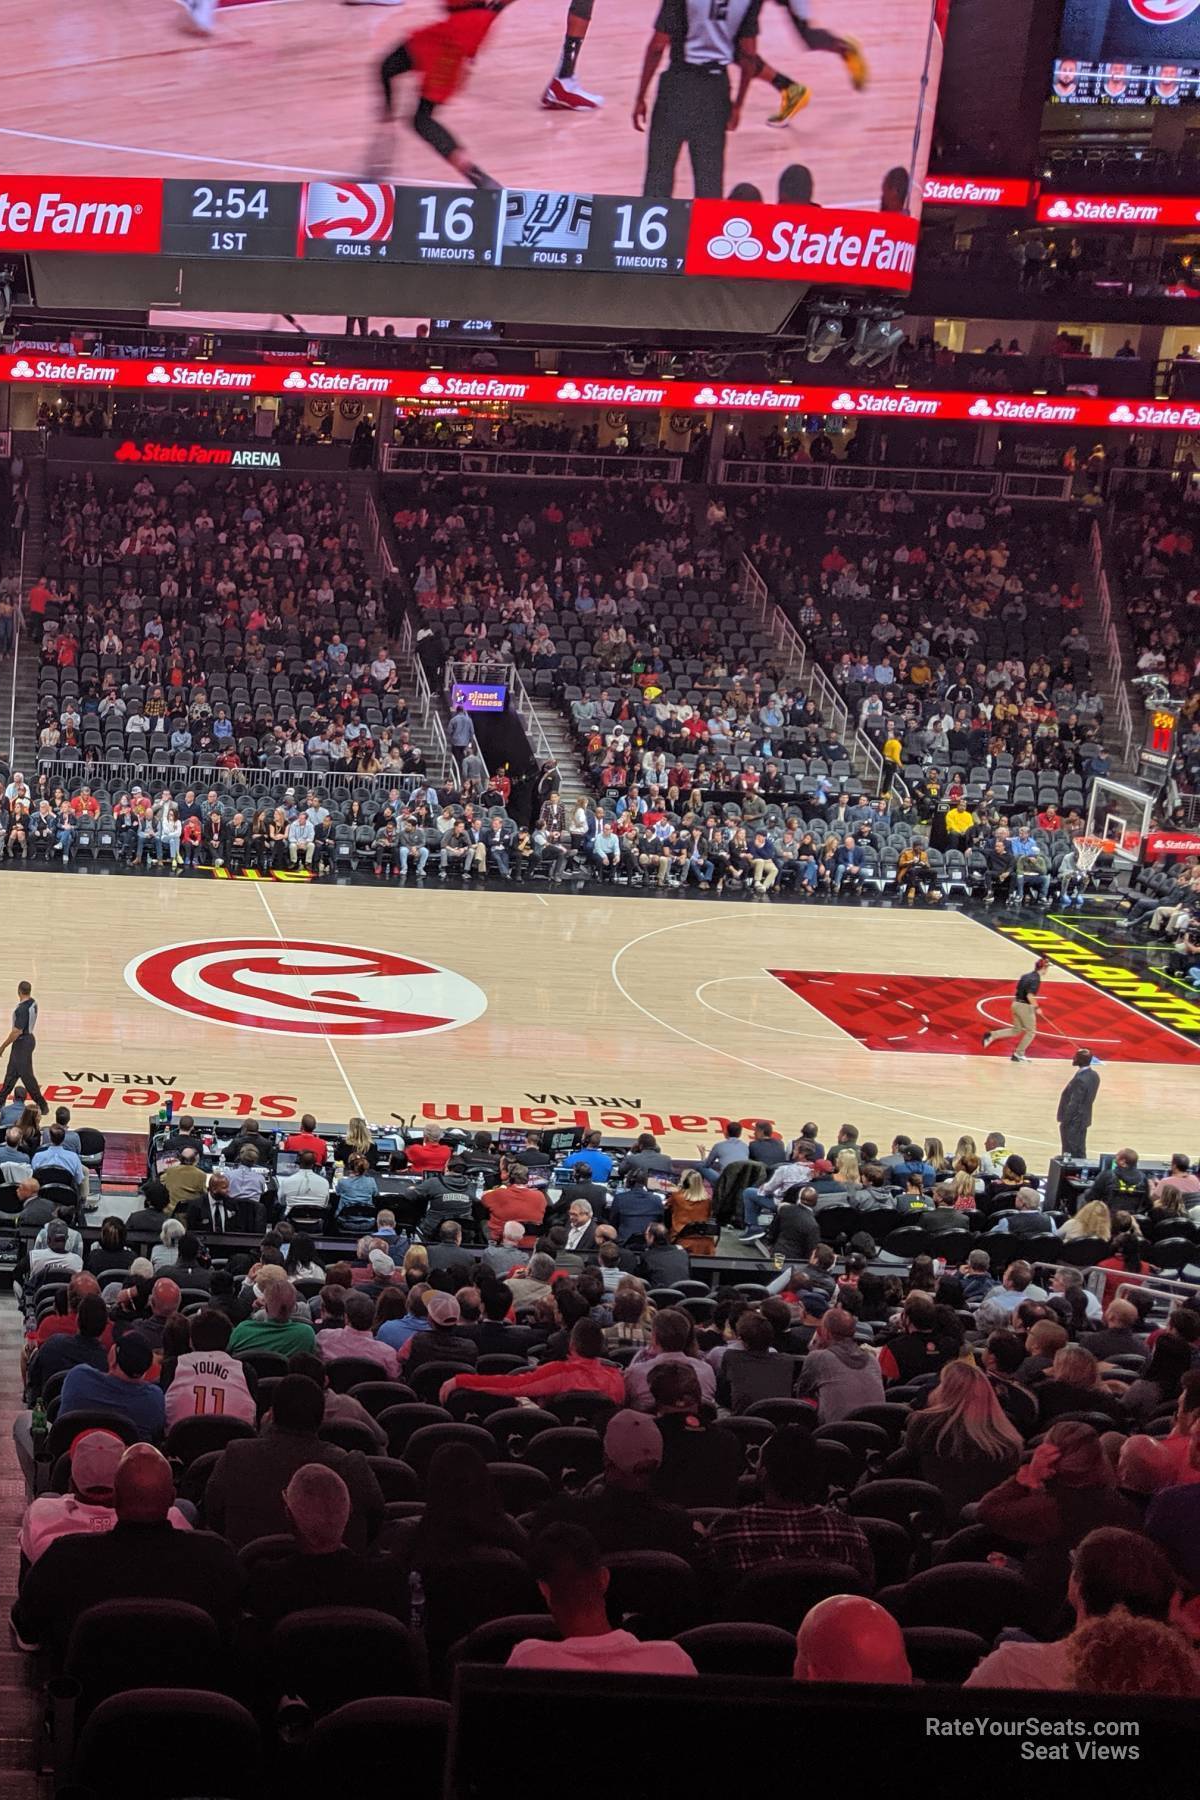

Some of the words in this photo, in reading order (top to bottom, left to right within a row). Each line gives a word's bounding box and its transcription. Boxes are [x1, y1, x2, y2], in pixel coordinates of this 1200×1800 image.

[191, 186, 269, 220] 2:54
[417, 195, 475, 242] 16
[613, 203, 669, 251] 16
[210, 232, 247, 251] 1ST
[335, 244, 371, 256] FOULS
[379, 245, 387, 257] 4
[420, 247, 475, 260] TIMEOUTS
[484, 249, 492, 261] 6
[532, 251, 568, 264] FOULS
[575, 253, 583, 265] 3
[615, 255, 668, 269] TIMEOUTS
[676, 258, 684, 270] 7
[462, 319, 493, 330] 2:54
[1134, 406, 1200, 427] StateFa
[231, 450, 281, 467] ARENA
[467, 690, 498, 701] planet
[471, 698, 503, 707] fitness
[63, 1070, 178, 1086] ARENA
[524, 1092, 642, 1109] ARENA
[192, 1361, 230, 1381] YOUNG
[193, 1385, 225, 1416] 11
